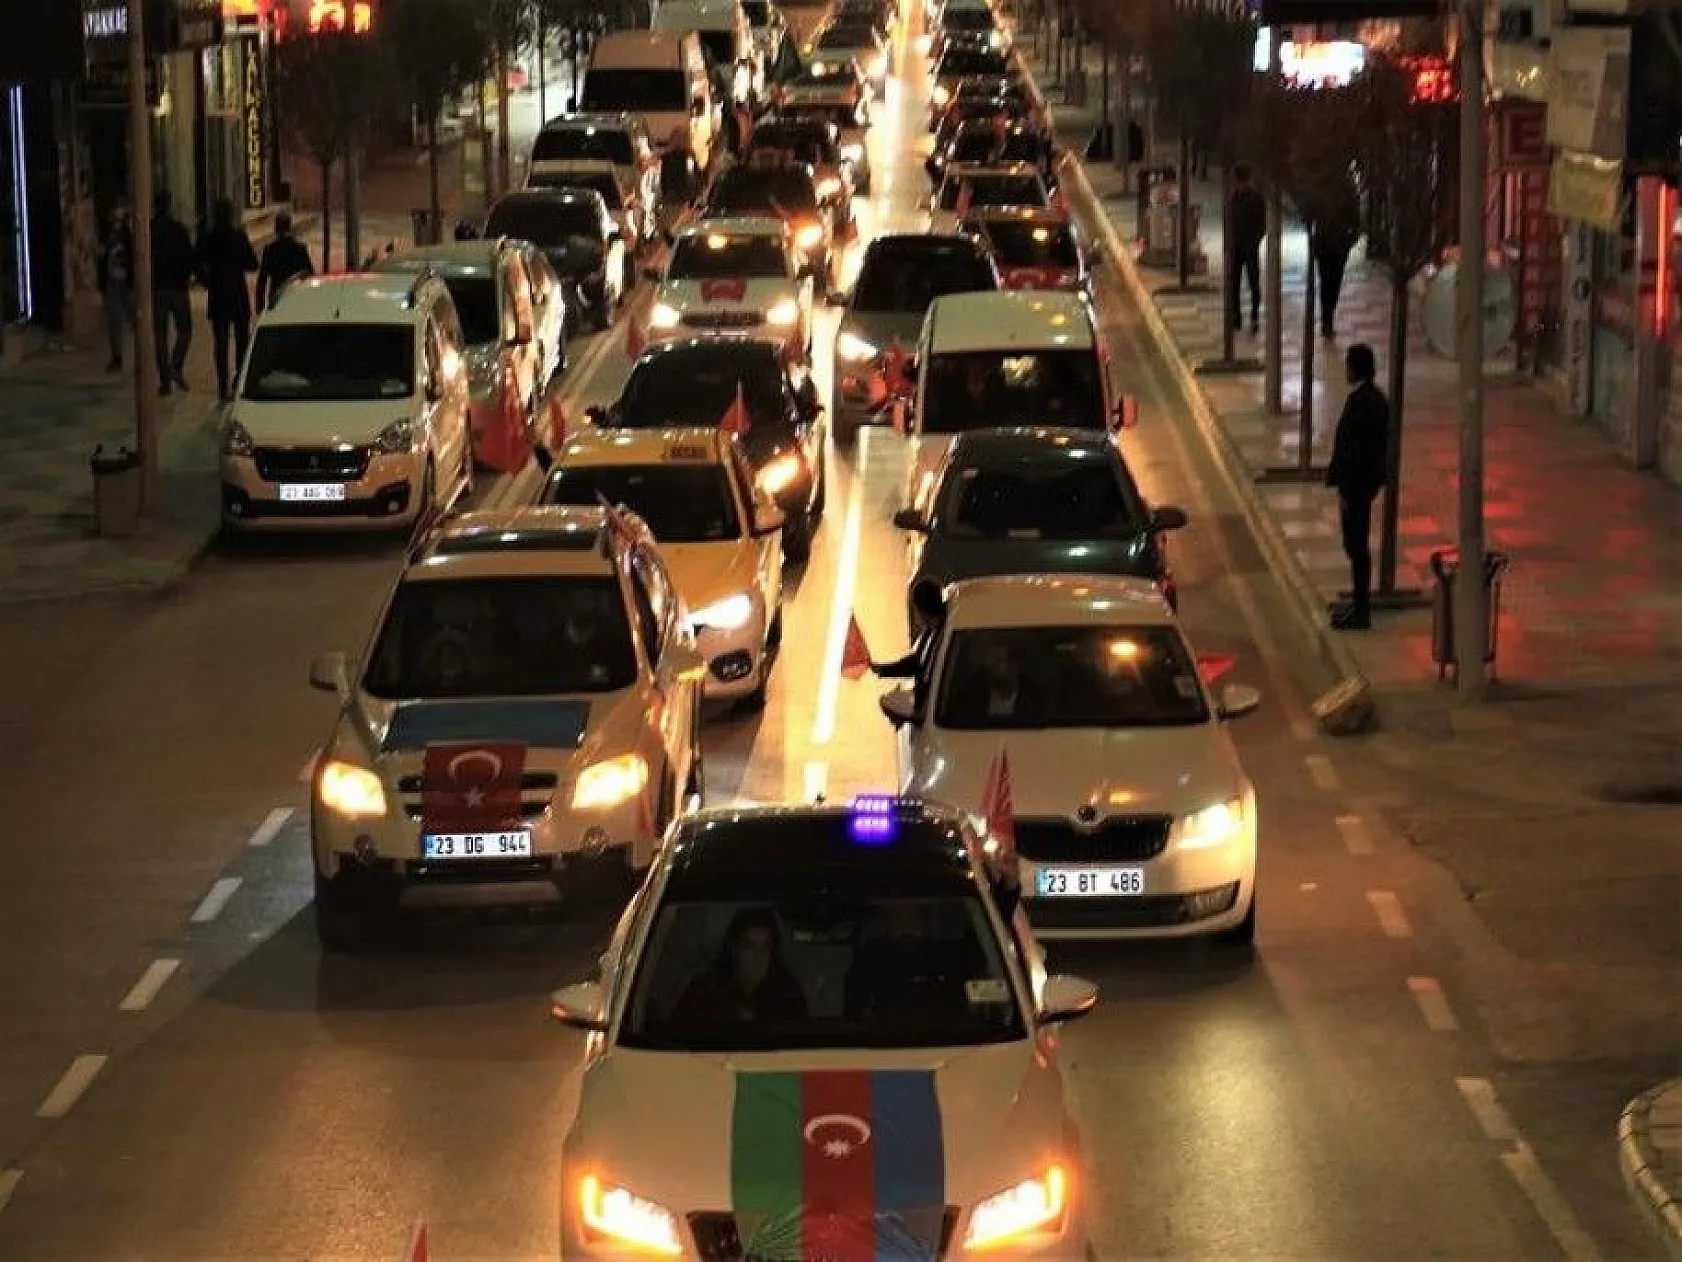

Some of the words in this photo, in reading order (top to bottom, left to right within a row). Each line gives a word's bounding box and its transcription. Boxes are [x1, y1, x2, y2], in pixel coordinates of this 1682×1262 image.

[436, 836, 454, 854] 23
[464, 836, 484, 854] DG
[499, 835, 528, 853] 944
[1047, 873, 1067, 893] 23
[1078, 873, 1098, 893] BT
[1110, 872, 1141, 892] 486
